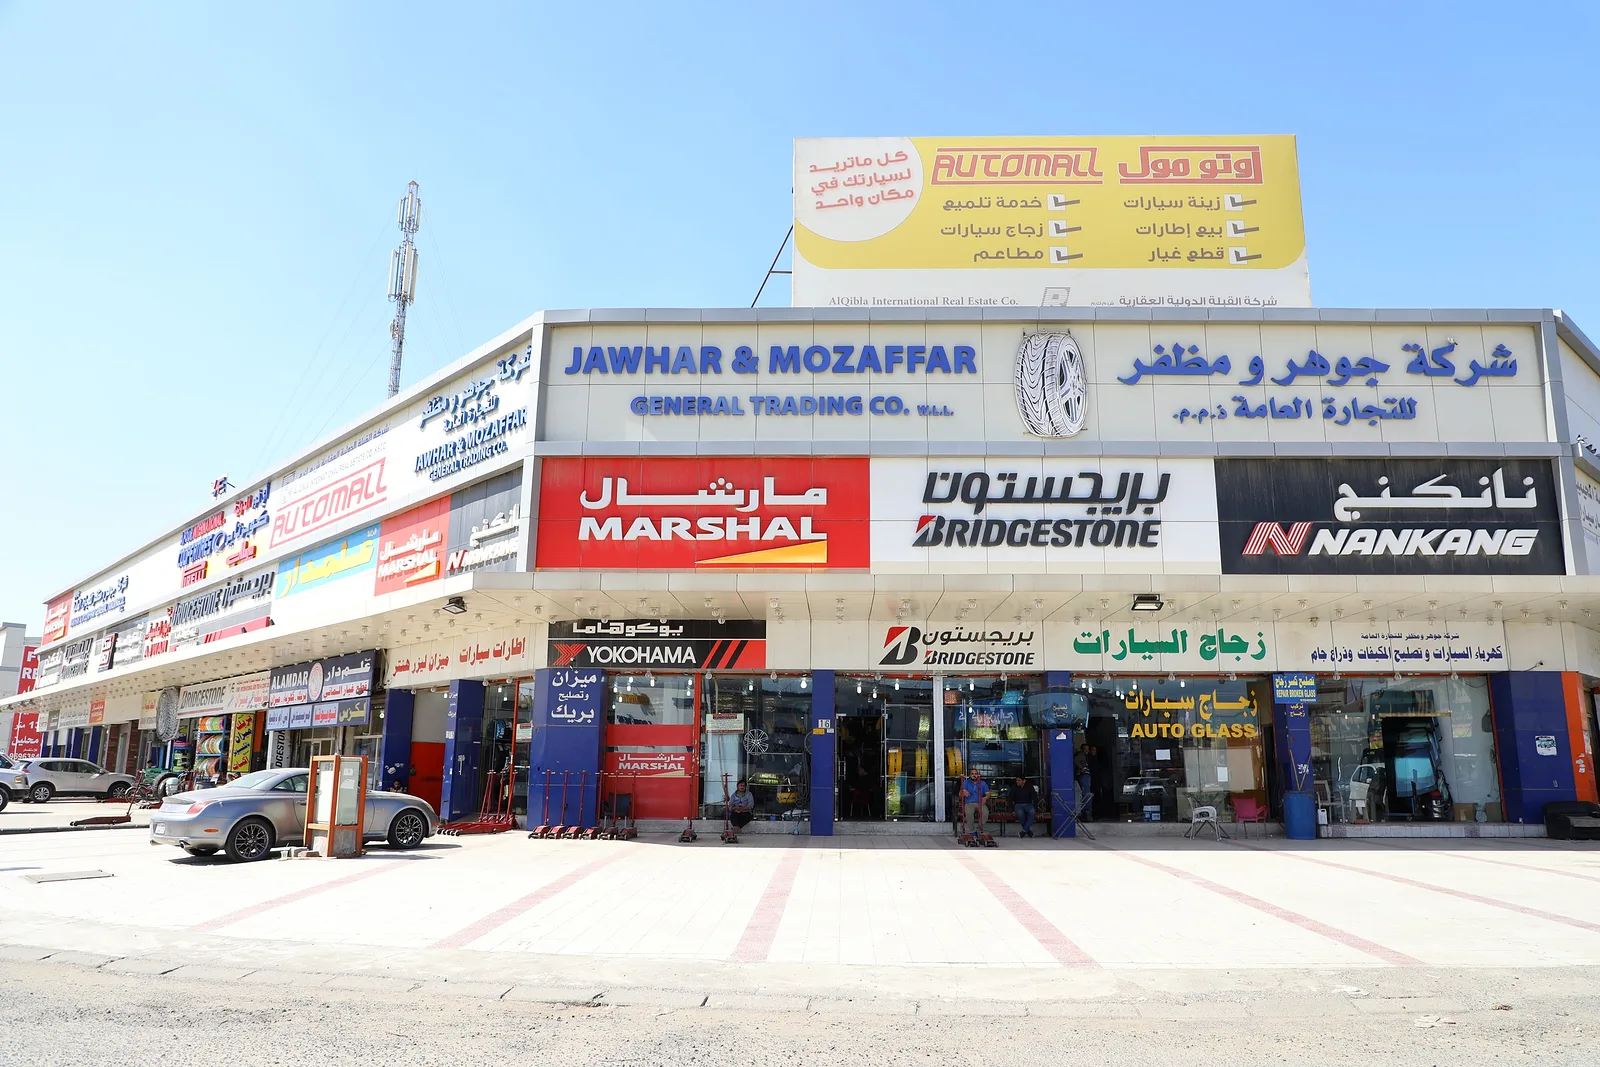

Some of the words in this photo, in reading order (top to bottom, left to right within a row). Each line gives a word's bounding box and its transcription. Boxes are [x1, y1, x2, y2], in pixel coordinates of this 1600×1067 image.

[877, 151, 909, 166] كل
[931, 147, 1103, 185] AUTOMALL
[1118, 146, 1190, 179] مول
[811, 177, 838, 196] في
[842, 168, 911, 187] لسيارتك
[816, 194, 864, 209] واحد
[868, 189, 914, 205] مكان
[943, 197, 991, 211] تلميع
[996, 196, 1042, 208] خدمة
[1124, 196, 1183, 211] سيارات
[1188, 196, 1221, 211] زينة
[941, 223, 1001, 238] سيارات
[1006, 223, 1044, 237] زجاج
[1136, 223, 1190, 238] إطارات
[1196, 224, 1223, 238] بيع
[974, 247, 1044, 262] مطاعم
[1148, 247, 1181, 261] غيار
[1187, 247, 1224, 261] قطع
[829, 296, 869, 306] AlQibla
[872, 296, 939, 306] International
[942, 296, 964, 306] Real
[967, 296, 998, 306] Estate
[1001, 296, 1018, 306] Co.
[1119, 297, 1164, 307] العقارية
[1167, 297, 1206, 307] الدولية
[1209, 297, 1241, 307] القبلة
[1244, 296, 1277, 307] شركة
[564, 346, 722, 375] JAWHAR
[731, 345, 759, 375] &
[768, 345, 977, 375] MOZAFFAR
[1117, 343, 1232, 385] مظفر
[1271, 349, 1391, 387] جوهر
[1401, 343, 1518, 387] شركة
[1239, 353, 1265, 386] و
[631, 396, 744, 417] GENERAL
[750, 395, 863, 417] TRADING
[869, 396, 911, 417] CO.
[1234, 395, 1313, 420] العامة
[1322, 396, 1418, 426] للتجارة
[415, 441, 456, 473] JAWHAR
[467, 408, 528, 452] MOZAFFAR
[429, 458, 460, 481] GENERAL
[460, 447, 491, 470] TRADING
[579, 476, 827, 512] مارشال
[921, 471, 1171, 515] بريجستون
[1333, 468, 1537, 523] نانكنج
[269, 457, 388, 550] AUTOMALL
[578, 516, 827, 542] MARSHAL
[912, 514, 1161, 548] BRIDGESTONE
[1307, 528, 1539, 556] NANKANG
[378, 550, 438, 578] MARSHAL
[170, 589, 223, 626] BRIDGESTONE
[573, 622, 684, 637] يوكوهاما
[922, 627, 1035, 646] بريجستون
[492, 637, 526, 661] إطارات
[1073, 628, 1188, 661] السيارات
[1199, 628, 1266, 662] زجاج
[429, 653, 449, 670] ميزان
[460, 644, 489, 665] سيارات
[586, 646, 696, 664] YOKOHAMA
[923, 650, 1035, 665] BRIDGESTONE
[1311, 647, 1327, 664] جام
[1357, 646, 1392, 662] المكيفات
[1393, 646, 1423, 662] تصليح
[1433, 646, 1472, 662] السيارات
[1474, 646, 1503, 662] كهرباء
[271, 671, 309, 690] ALAMDAR
[552, 668, 597, 687] ميزان
[180, 686, 226, 709] BRIDGESTONE
[558, 691, 590, 701] وتصليح
[1276, 689, 1289, 698] REPAIR
[1289, 689, 1304, 698] BROKEN
[1304, 689, 1316, 698] GLASS
[1125, 689, 1195, 718] سيارات
[1199, 689, 1258, 720] زجاج
[551, 705, 595, 723] بريك
[819, 720, 830, 728] 16
[1131, 723, 1184, 738] AUTO
[1191, 723, 1256, 738] GLASS
[618, 753, 686, 763] مارشال
[618, 762, 685, 770] MARSHAL
